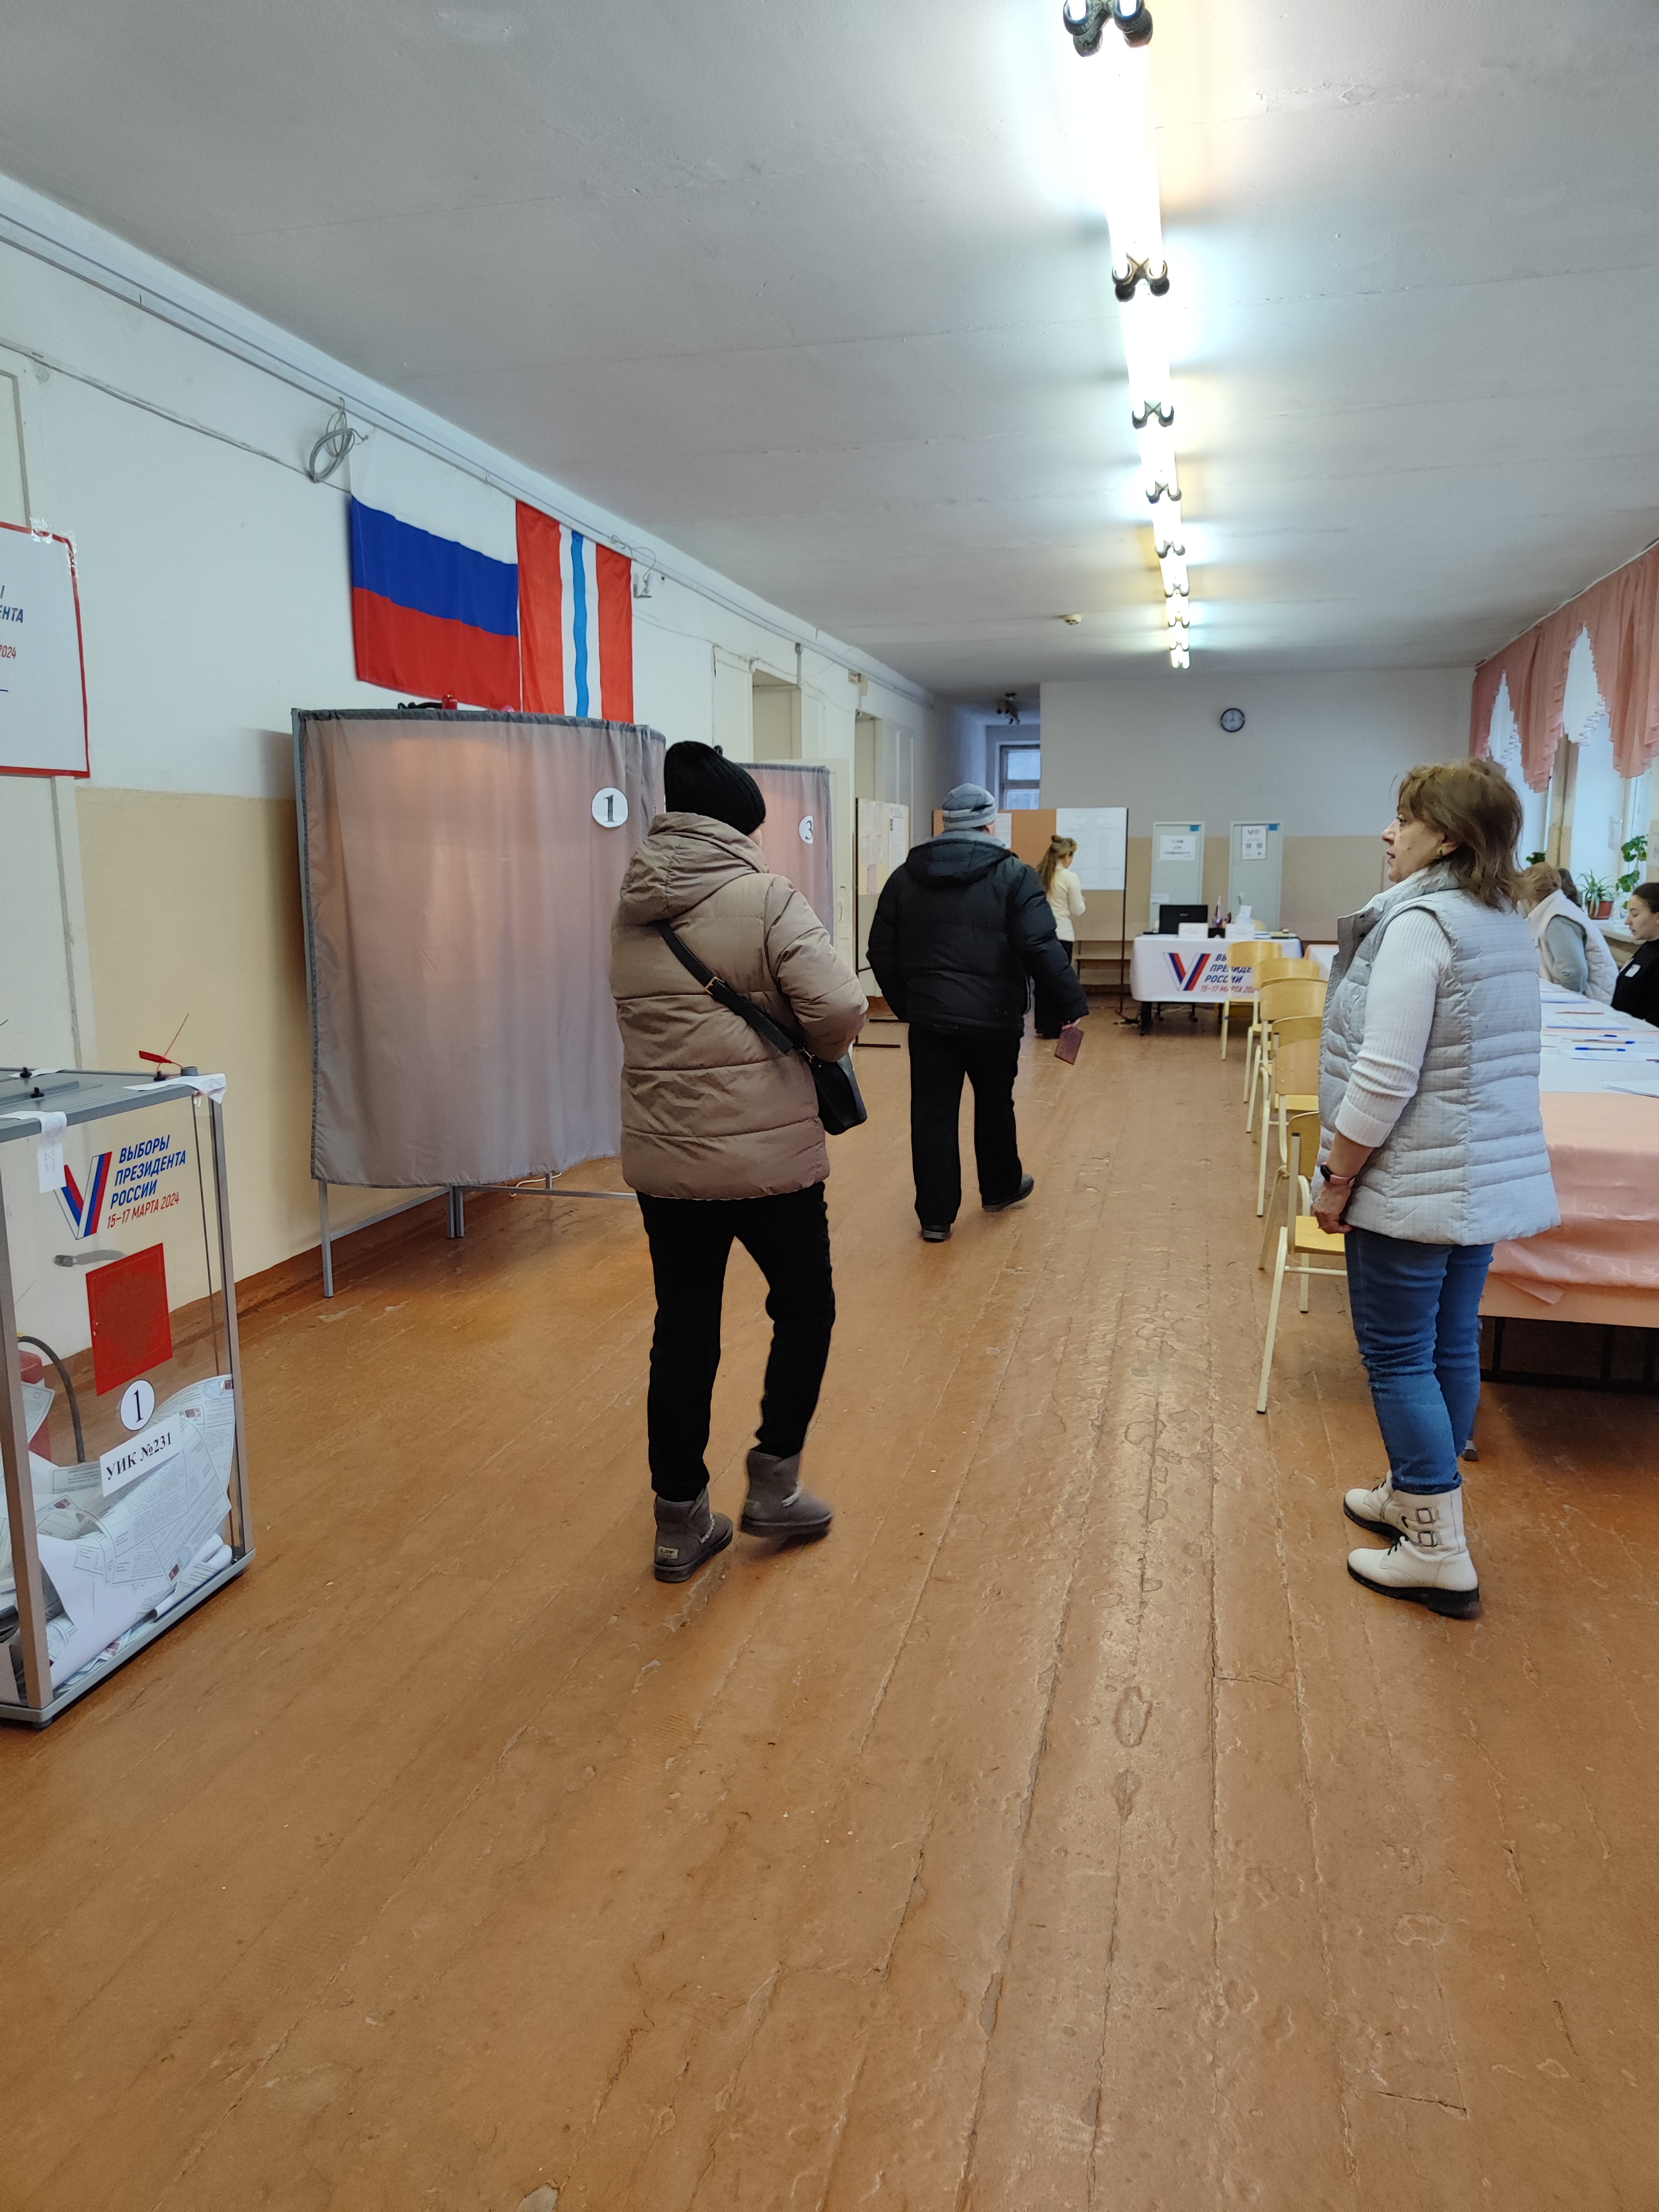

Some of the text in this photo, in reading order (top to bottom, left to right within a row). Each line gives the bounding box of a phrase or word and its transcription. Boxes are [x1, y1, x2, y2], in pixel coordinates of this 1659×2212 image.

[603, 794, 618, 823] 1
[805, 820, 813, 840] 3
[119, 1134, 170, 1164] ВЫБОРЫ
[114, 1150, 186, 1187] ПРЕЗИДЕНТА
[110, 1179, 158, 1209] РОССИИ
[131, 1199, 159, 1220] МАРТА
[160, 1191, 180, 1210] 2024
[133, 1389, 144, 1423] 1
[106, 1452, 137, 1480] УИК
[140, 1432, 171, 1462] №231
